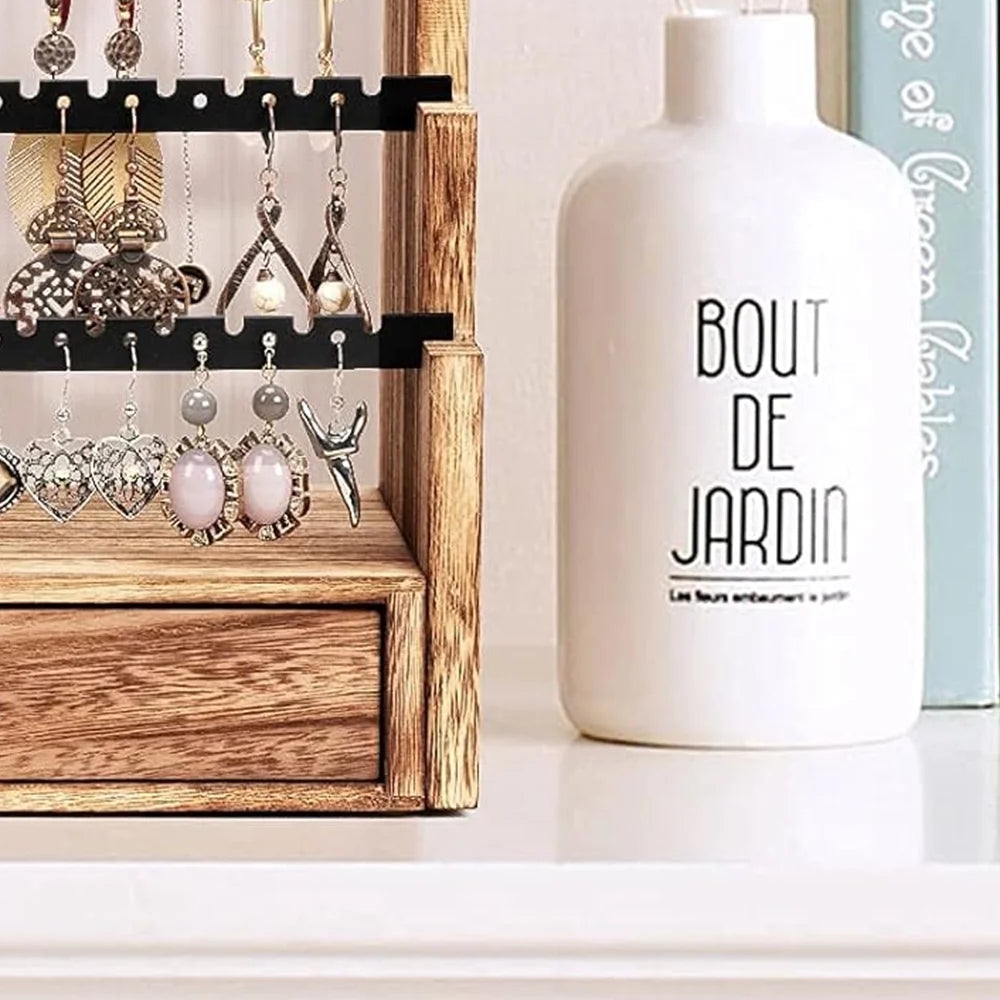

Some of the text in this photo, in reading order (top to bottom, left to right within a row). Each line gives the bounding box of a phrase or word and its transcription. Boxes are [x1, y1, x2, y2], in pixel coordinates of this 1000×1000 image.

[901, 80, 954, 132] of
[697, 298, 828, 377] BOUT
[733, 394, 794, 471] DE
[670, 486, 847, 565] JARDIN
